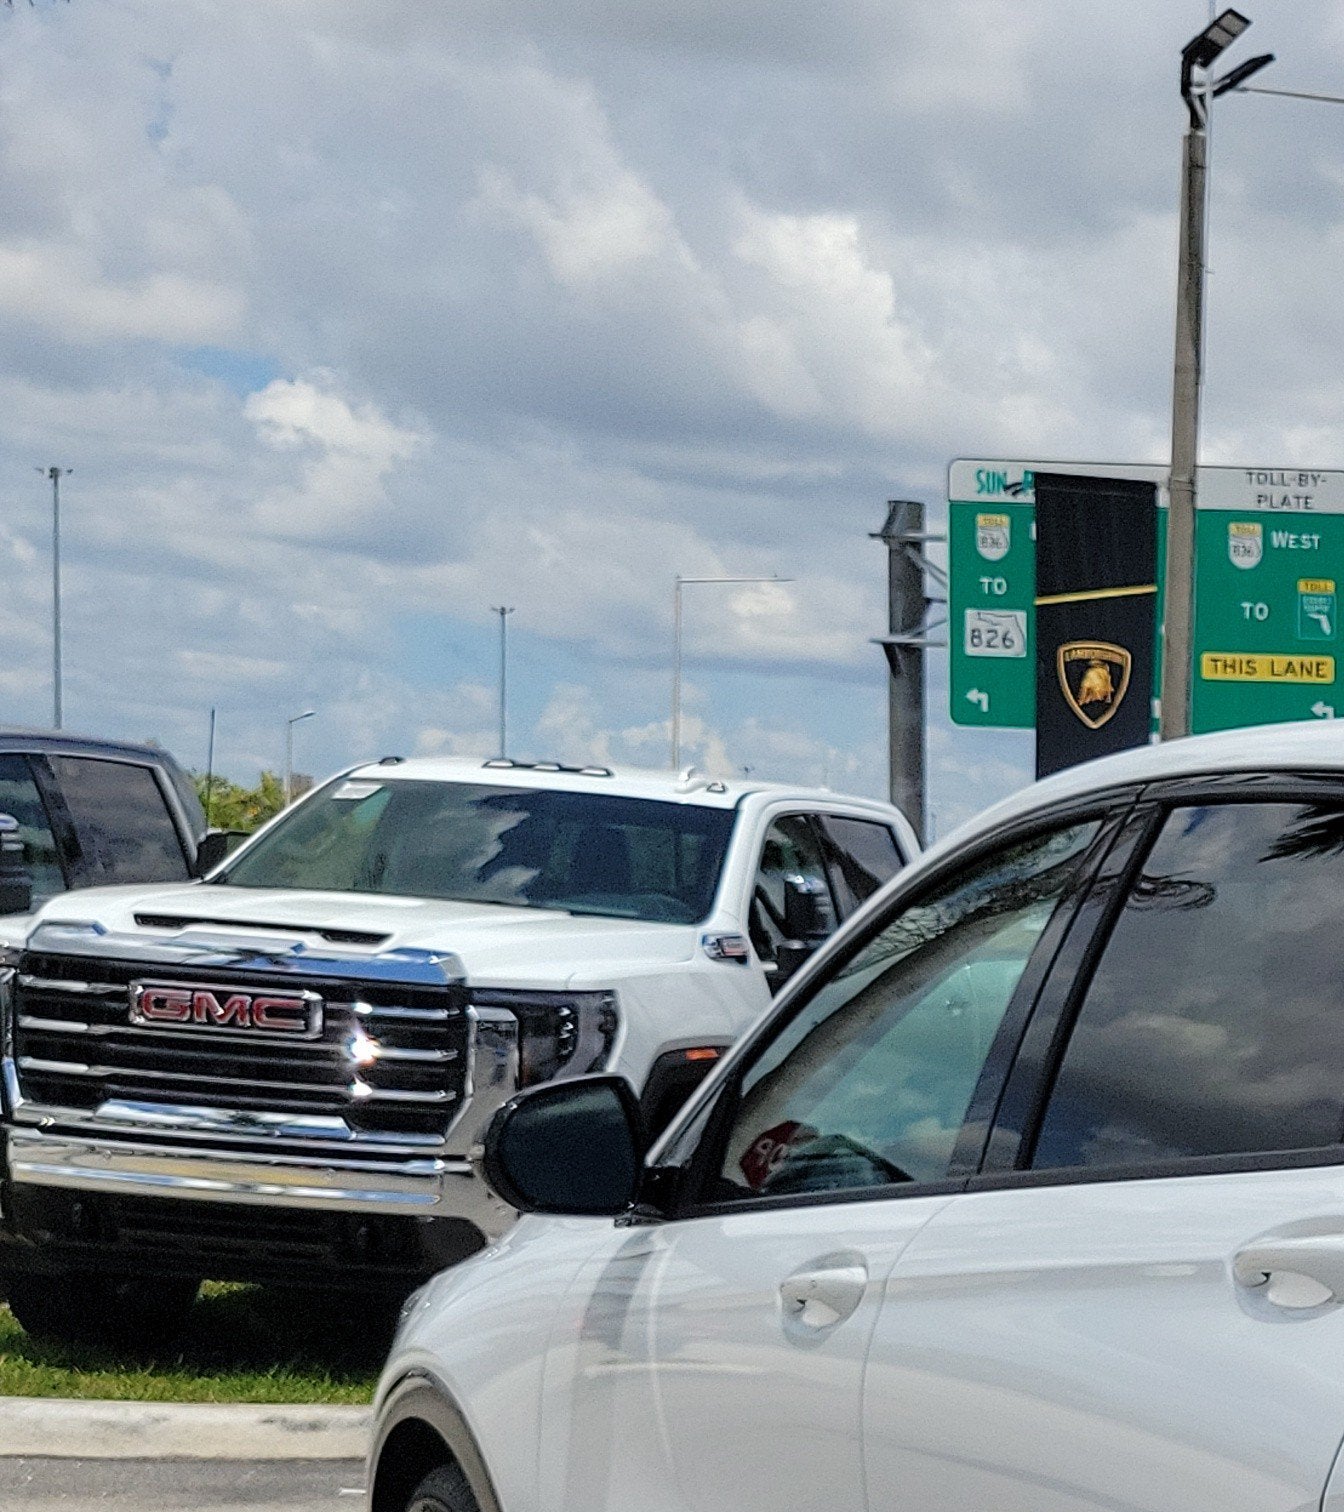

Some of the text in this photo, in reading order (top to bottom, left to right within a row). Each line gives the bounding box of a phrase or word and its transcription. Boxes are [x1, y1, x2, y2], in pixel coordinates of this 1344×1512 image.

[1246, 472, 1328, 488] TOLL-BY-
[1257, 494, 1314, 510] PLATE
[1271, 530, 1321, 550] WEST
[979, 577, 1007, 595] TO
[1304, 582, 1329, 591] TOLL
[1241, 601, 1269, 620] TO
[969, 628, 1015, 650] 826
[1210, 659, 1327, 678] THIS LANE
[141, 988, 306, 1031] GMC
